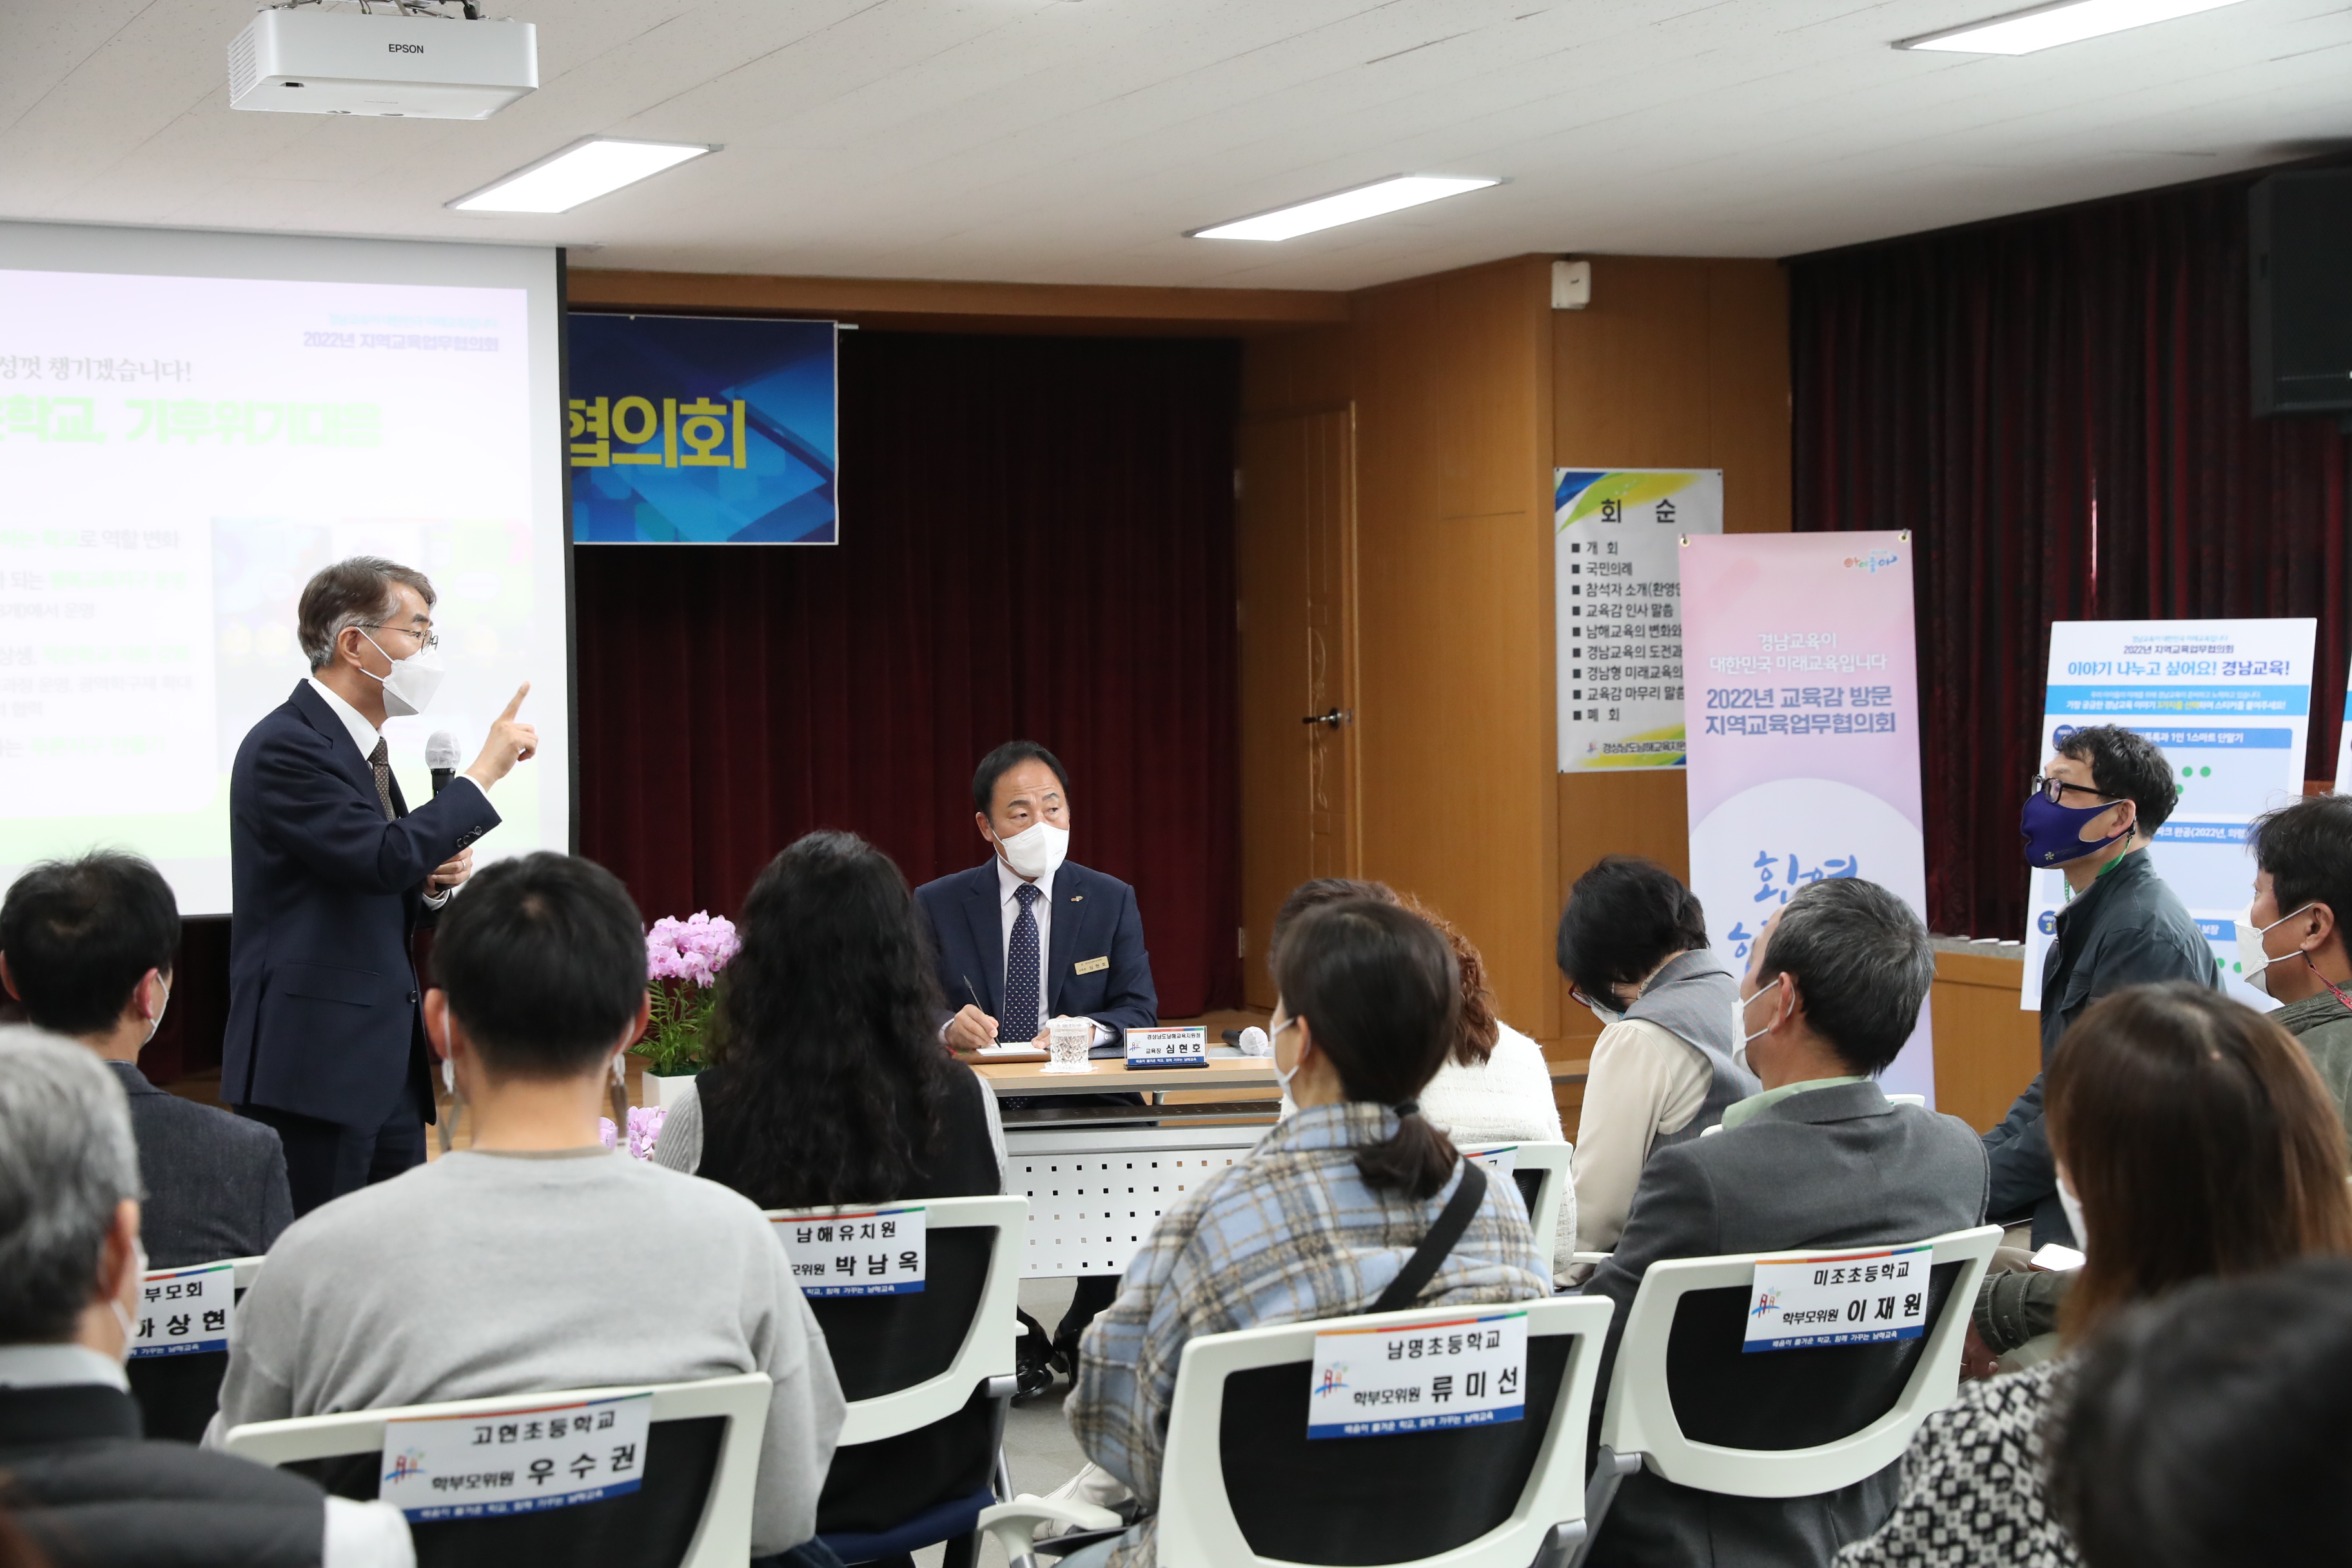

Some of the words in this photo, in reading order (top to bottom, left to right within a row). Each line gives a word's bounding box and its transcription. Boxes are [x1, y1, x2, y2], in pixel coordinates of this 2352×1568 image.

[389, 44, 424, 54] EPSON
[303, 331, 355, 348] 2022년
[360, 333, 499, 353] 지역교육업무협의회
[48, 356, 192, 383] 챙기겠습니다!
[0, 393, 108, 445] 학교,
[124, 398, 384, 449] 기후위기대응
[101, 529, 139, 549] 역할
[142, 529, 180, 549] 변화
[1586, 562, 1633, 576] 국민의례
[1587, 582, 1622, 598] 참석자
[64, 602, 95, 619] 운영
[1586, 603, 1622, 618] 교육감
[1625, 603, 1648, 618] 인사
[1651, 603, 1674, 618] 말씀
[1587, 624, 1645, 639] 남해교육의
[1758, 632, 1837, 652] 경남교육이
[2123, 645, 2151, 654] 2022년
[2155, 645, 2235, 654] 지역교육업무협의회
[1587, 645, 1645, 660] 경남교육의
[1587, 665, 1622, 681] 경남형
[1625, 665, 1683, 680] 미래교육의
[1709, 656, 1773, 674] 대한민국
[1776, 654, 1888, 673] 미래교육입니다
[2068, 662, 2112, 676] 이야기
[2117, 662, 2161, 676] 나누고
[2166, 661, 2217, 676] 싶어요!
[2222, 661, 2290, 676] 경남교육!
[1587, 687, 1622, 701] 교육감
[1625, 687, 1661, 701] 마무리
[1707, 688, 1774, 709] 2022년
[1780, 687, 1845, 709] 교육감
[1850, 685, 1893, 707] 방문
[1705, 712, 1896, 736] 지역교육업무협의회
[2217, 732, 2244, 744] 단말기
[797, 1220, 896, 1244] 남해유치원
[1813, 1261, 1910, 1286] 미조초등학교
[1782, 1308, 1839, 1326] 학부모위원
[1387, 1329, 1501, 1360] 남명초등학교
[1850, 1333, 1870, 1342] 가꾸는
[1872, 1330, 1897, 1340] 남해교육
[1353, 1387, 1421, 1407] 학부모위원
[471, 1409, 616, 1446] 고현초등학교
[431, 1470, 514, 1492] 학부모위원
